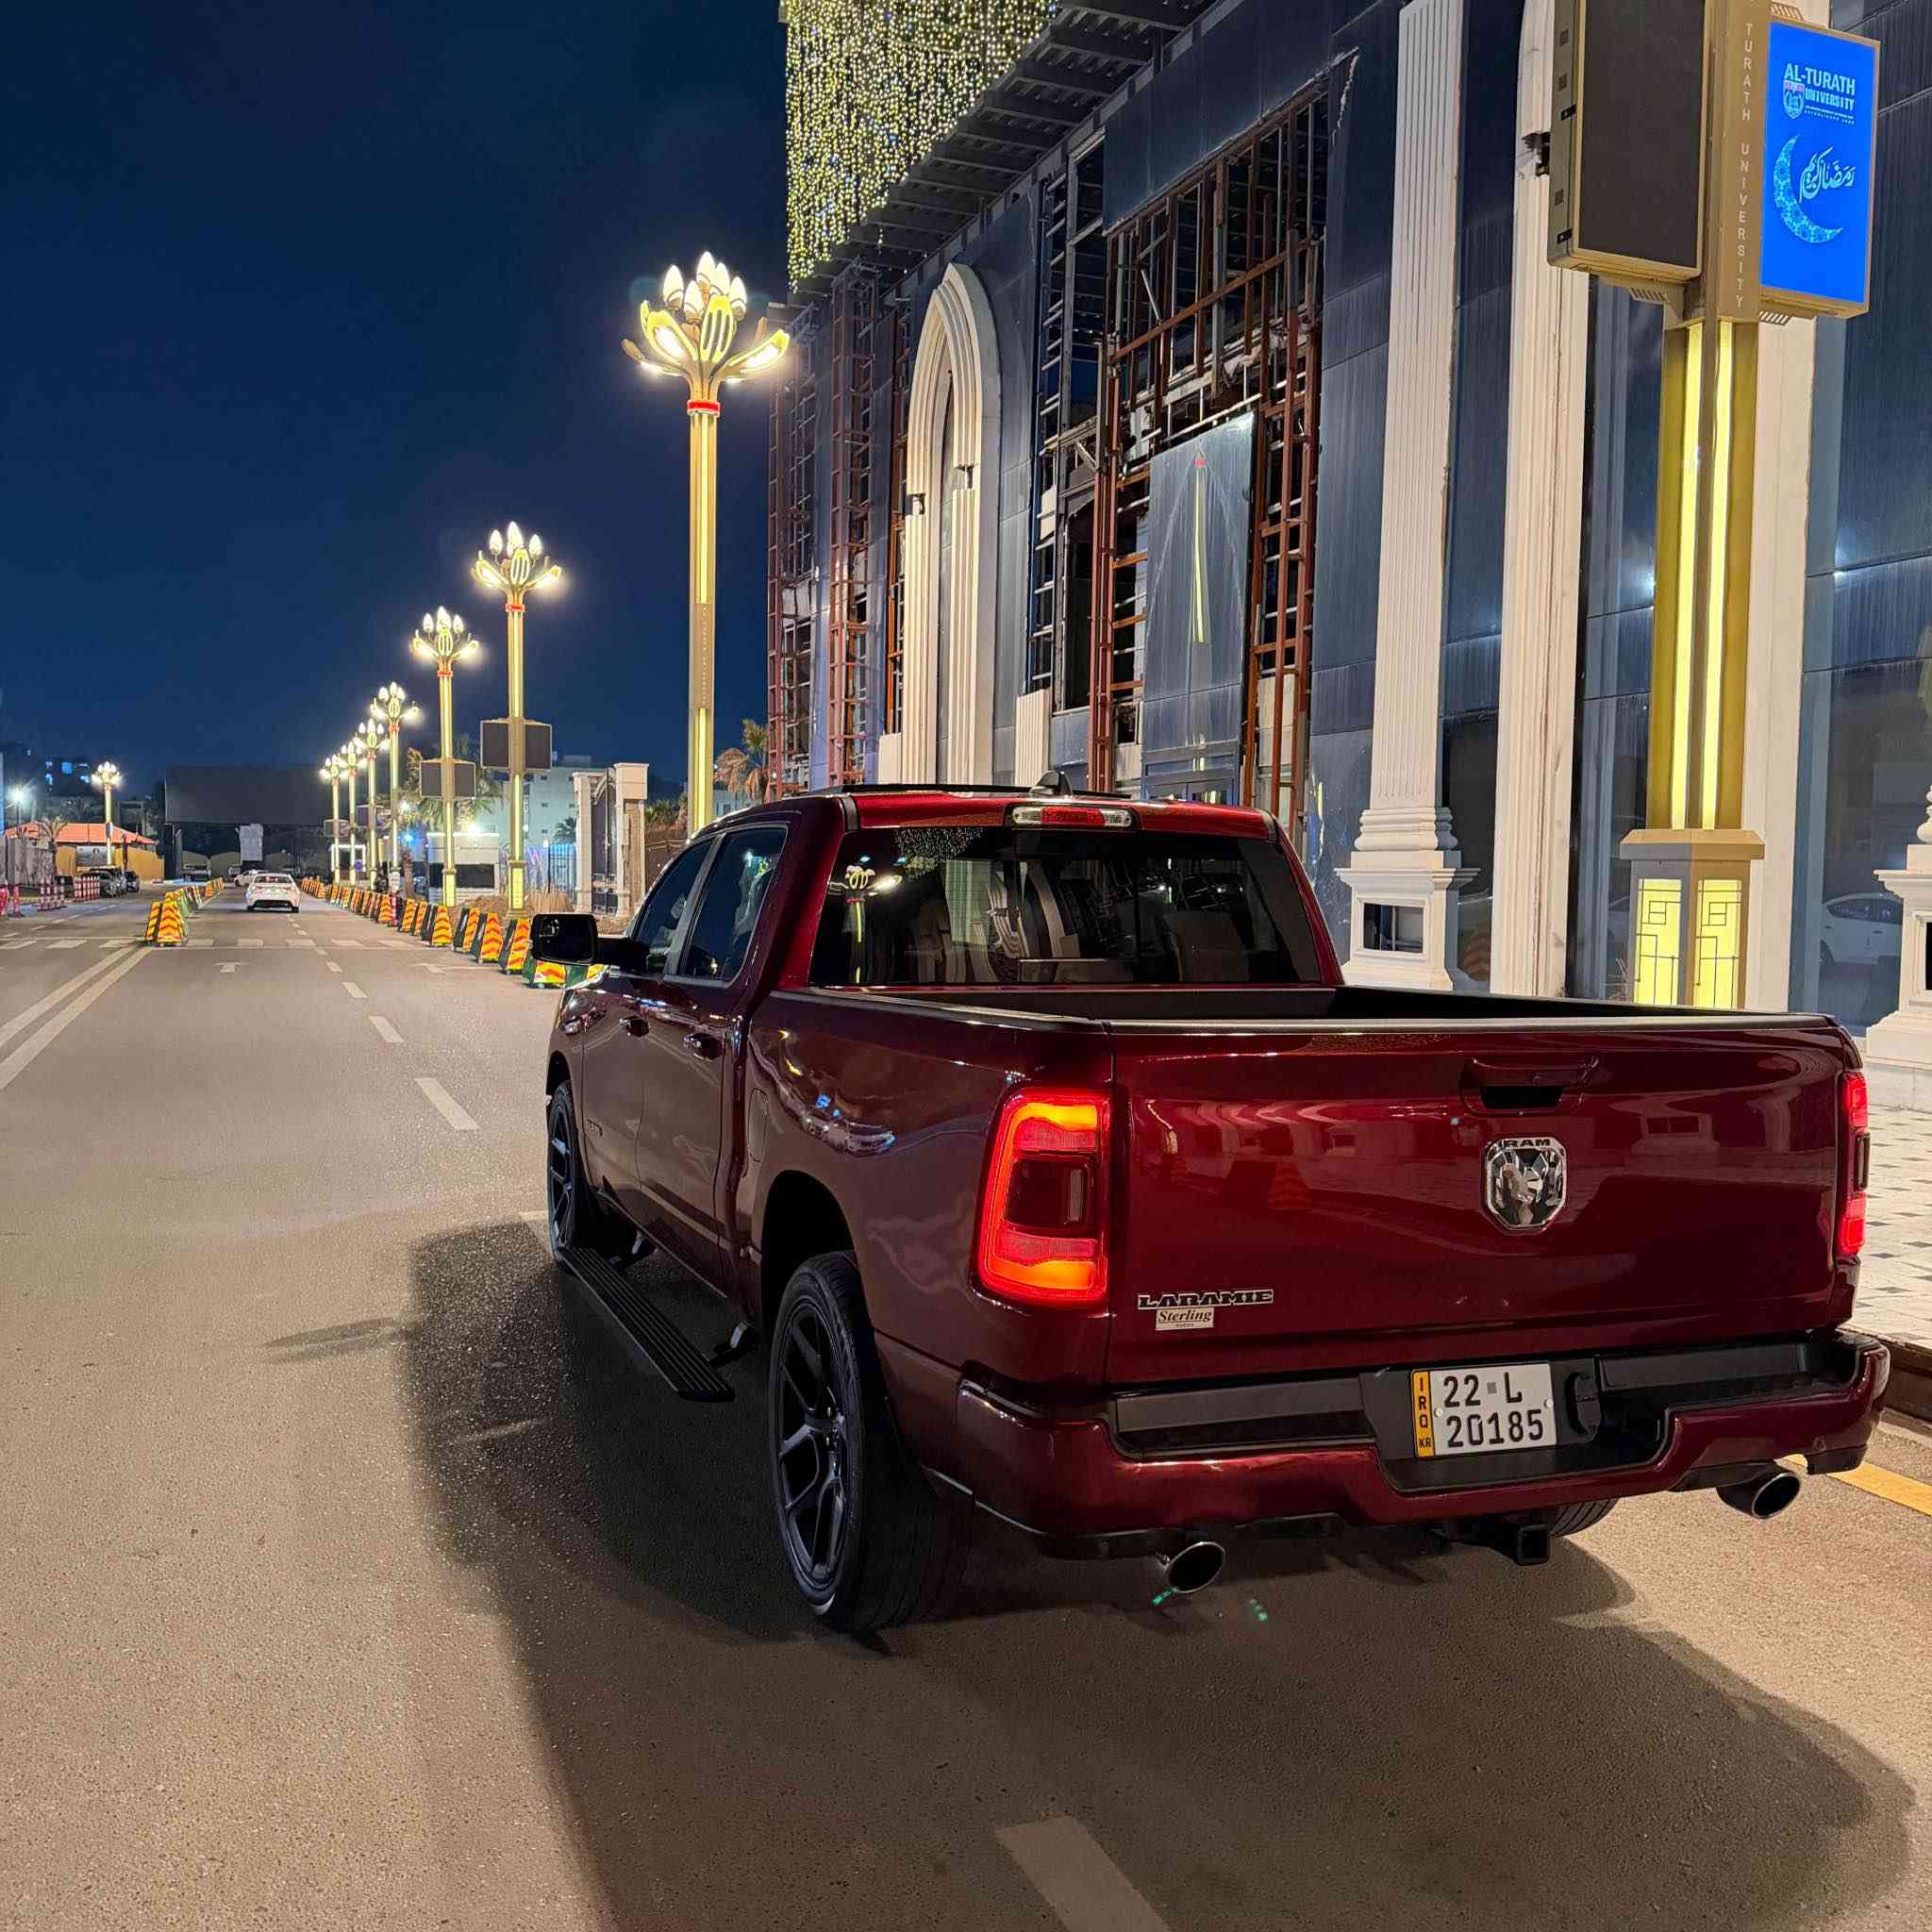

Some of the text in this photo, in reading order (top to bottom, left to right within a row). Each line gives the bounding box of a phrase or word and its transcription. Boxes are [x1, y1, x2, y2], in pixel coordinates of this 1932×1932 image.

[1784, 62, 1856, 96] AL-TURATH
[1805, 88, 1855, 111] UNIVERSITY
[1736, 23, 1754, 308] TURATH UNIVERSITY
[1505, 1139, 1551, 1148] RAM
[1138, 1289, 1274, 1310] LARAMIE
[1158, 1309, 1213, 1323] Sterling
[1443, 1372, 1523, 1407] 22 L
[1446, 1408, 1543, 1448] 20185
[1418, 1436, 1431, 1449] KR
